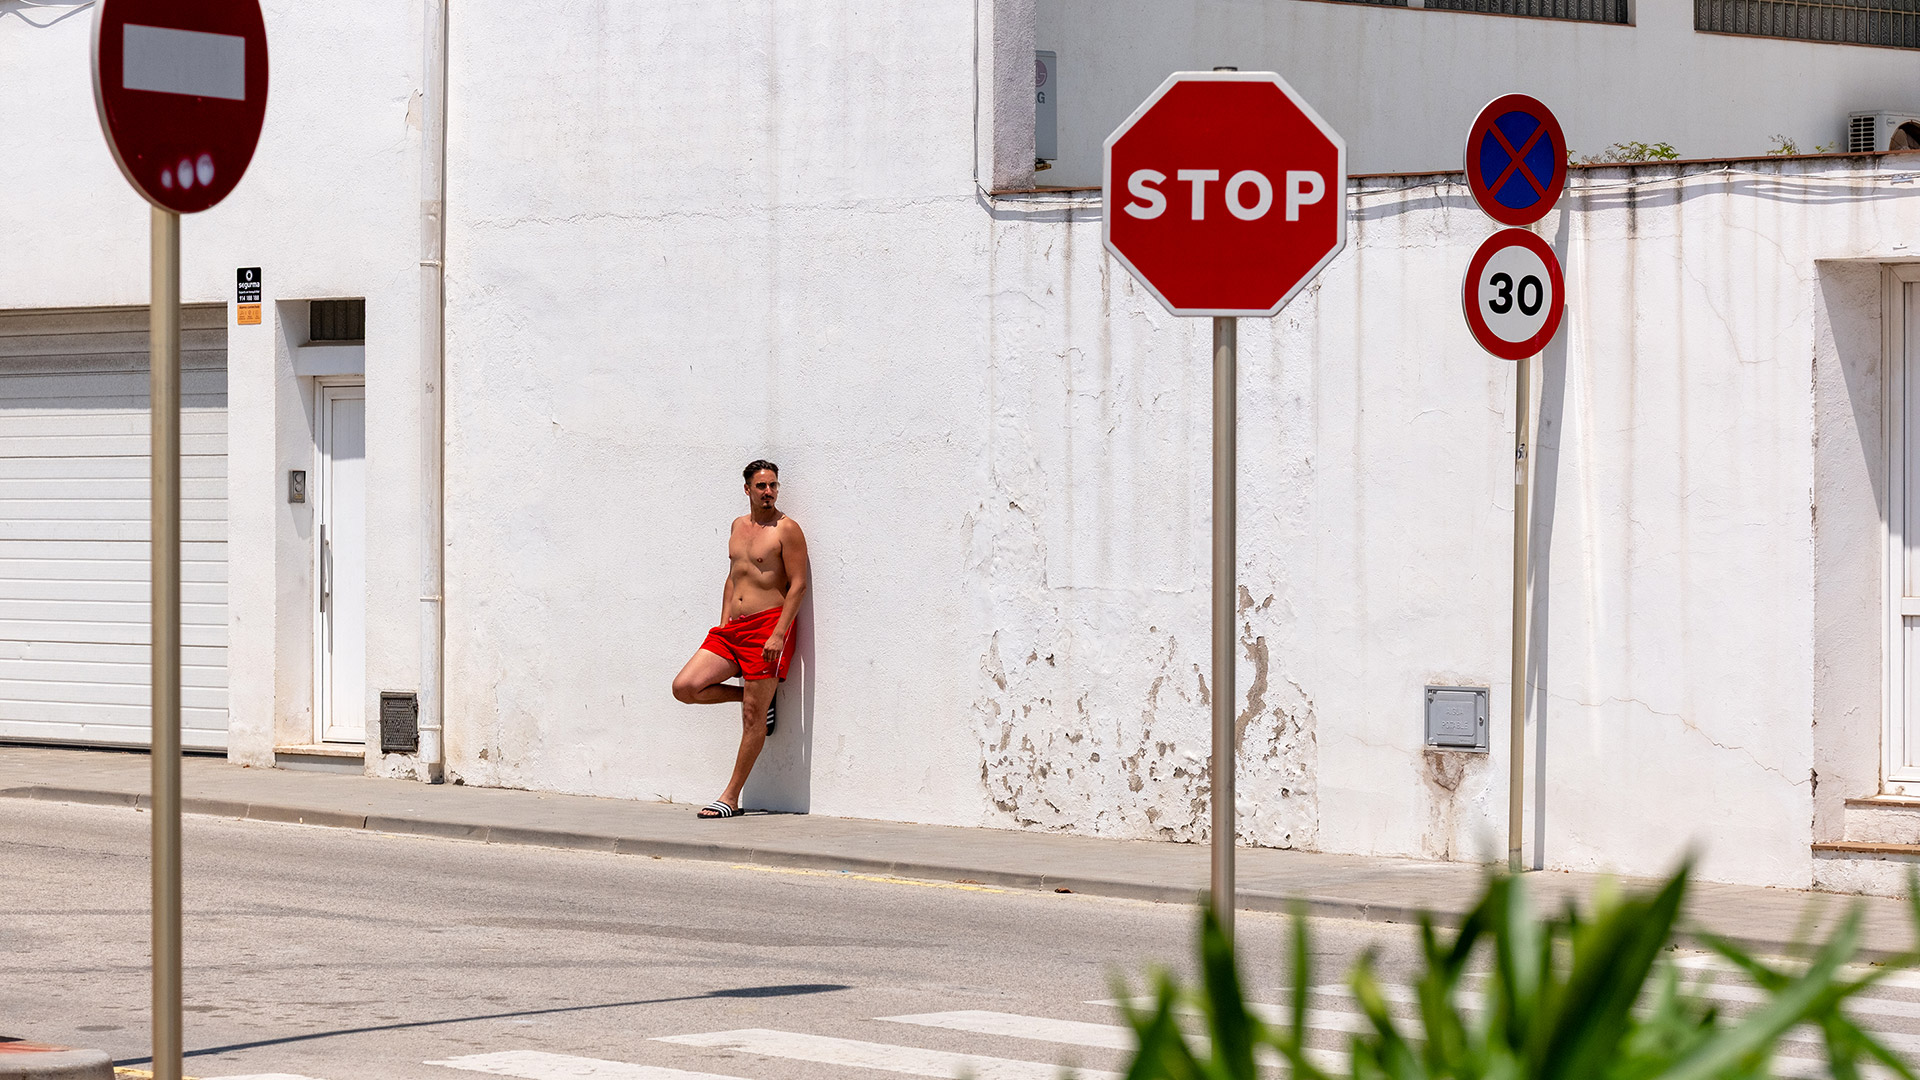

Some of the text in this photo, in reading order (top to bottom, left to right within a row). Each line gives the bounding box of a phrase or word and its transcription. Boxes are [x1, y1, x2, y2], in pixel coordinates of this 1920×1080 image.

[1036, 91, 1046, 104] G
[1123, 168, 1326, 222] STOP
[1488, 271, 1544, 317] 30
[1442, 720, 1468, 730] POTABLE
